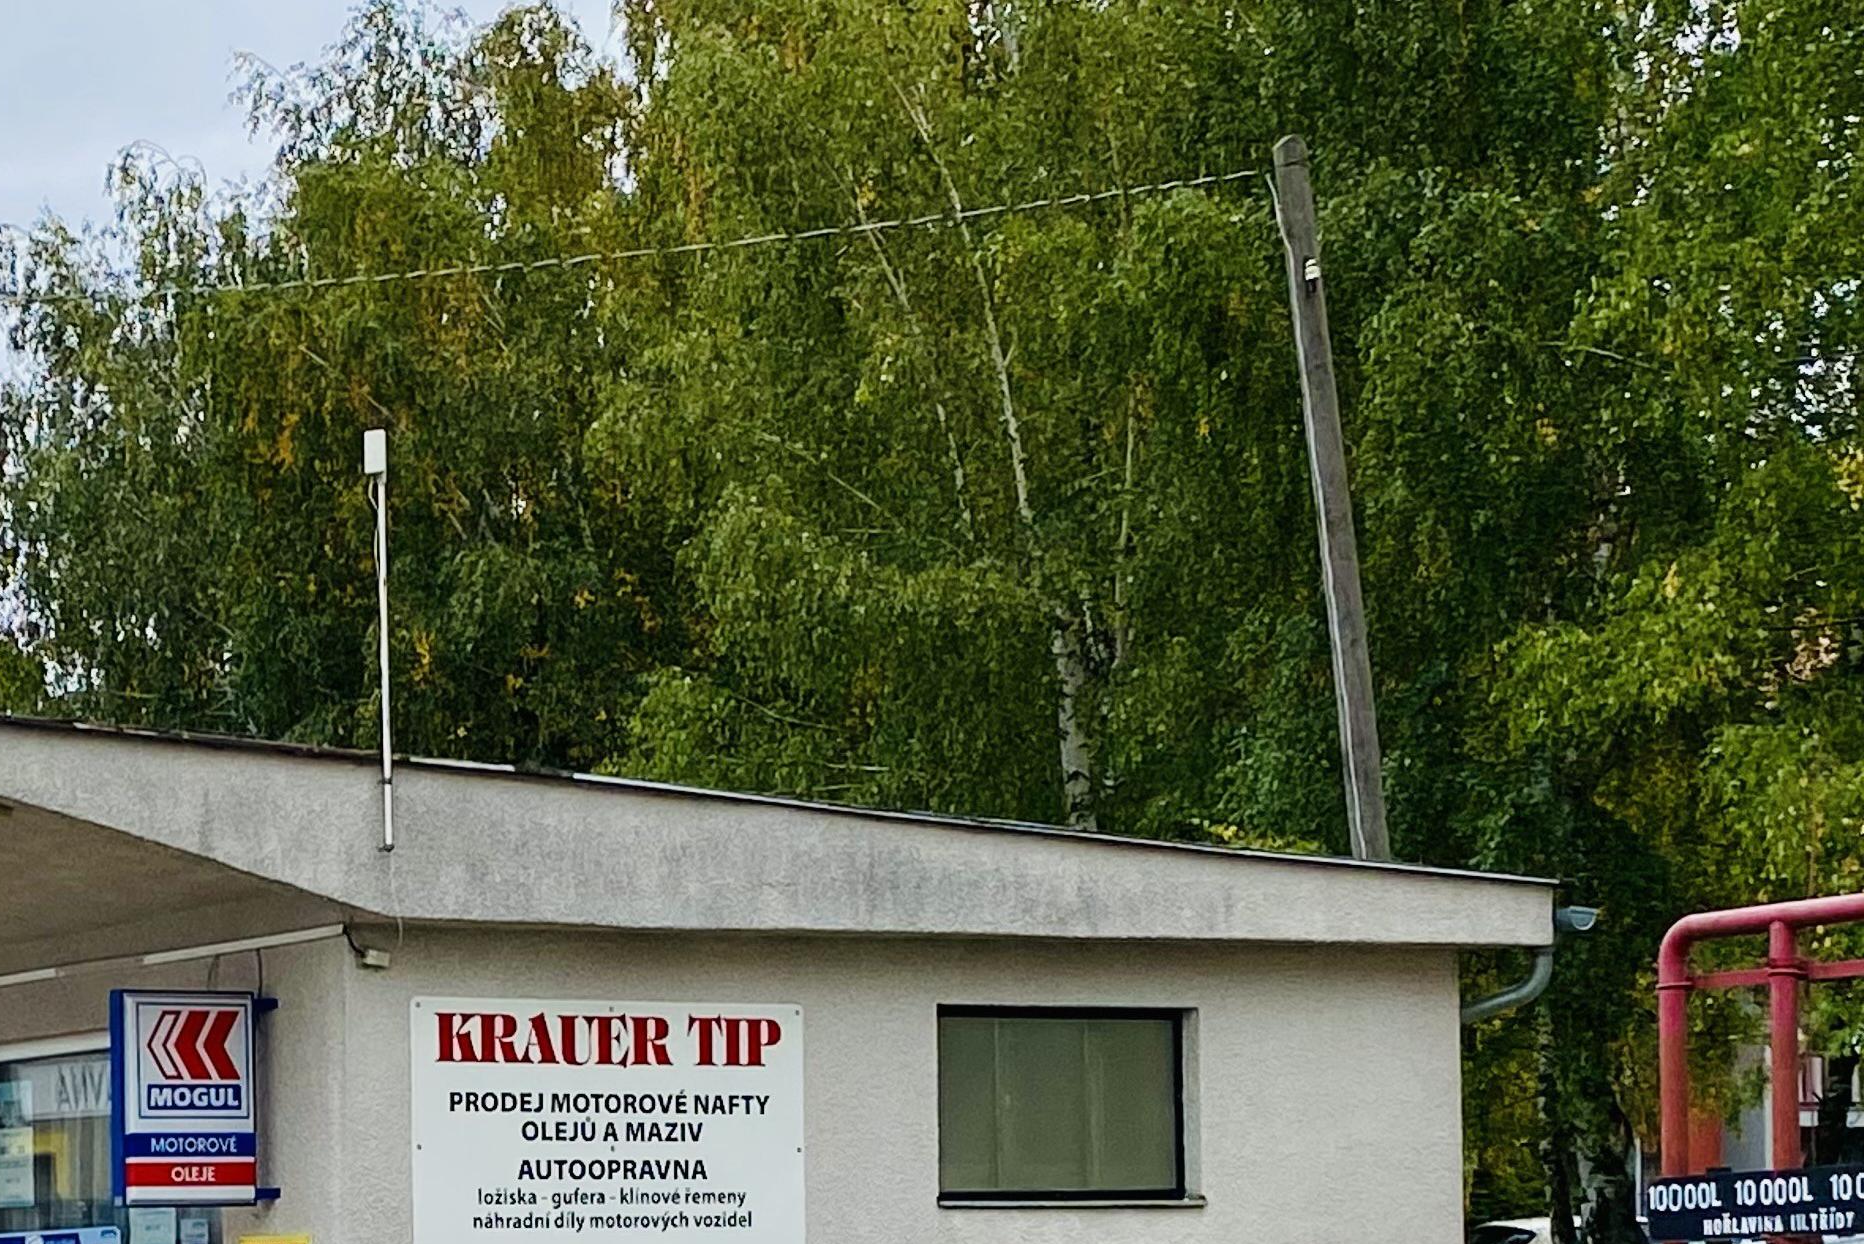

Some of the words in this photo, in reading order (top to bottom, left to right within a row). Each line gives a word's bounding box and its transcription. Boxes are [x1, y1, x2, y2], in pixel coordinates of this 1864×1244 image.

[435, 1012, 673, 1068] KRAUER
[687, 1014, 782, 1067] TIP
[150, 1087, 239, 1107] MOGUL
[449, 1092, 544, 1113] PRODEJ
[551, 1089, 687, 1114] MOTOROVÉ
[694, 1095, 770, 1115] NAFTY
[603, 1122, 619, 1142] A
[626, 1122, 703, 1142] MAZIV
[151, 1135, 237, 1153] MOTOROVÉ
[171, 1166, 216, 1182] OLEJE
[517, 1159, 708, 1180] AUTOOPRAVNA
[478, 1187, 537, 1205] ložiska
[552, 1187, 605, 1209] gufera
[620, 1187, 681, 1205] klínové
[686, 1187, 746, 1208] řemeny
[473, 1211, 550, 1229] náhradní
[554, 1211, 585, 1233] díly
[590, 1211, 689, 1232] motorových
[694, 1210, 752, 1228] vozidel
[1703, 1213, 1784, 1236] HOŘLAVINA
